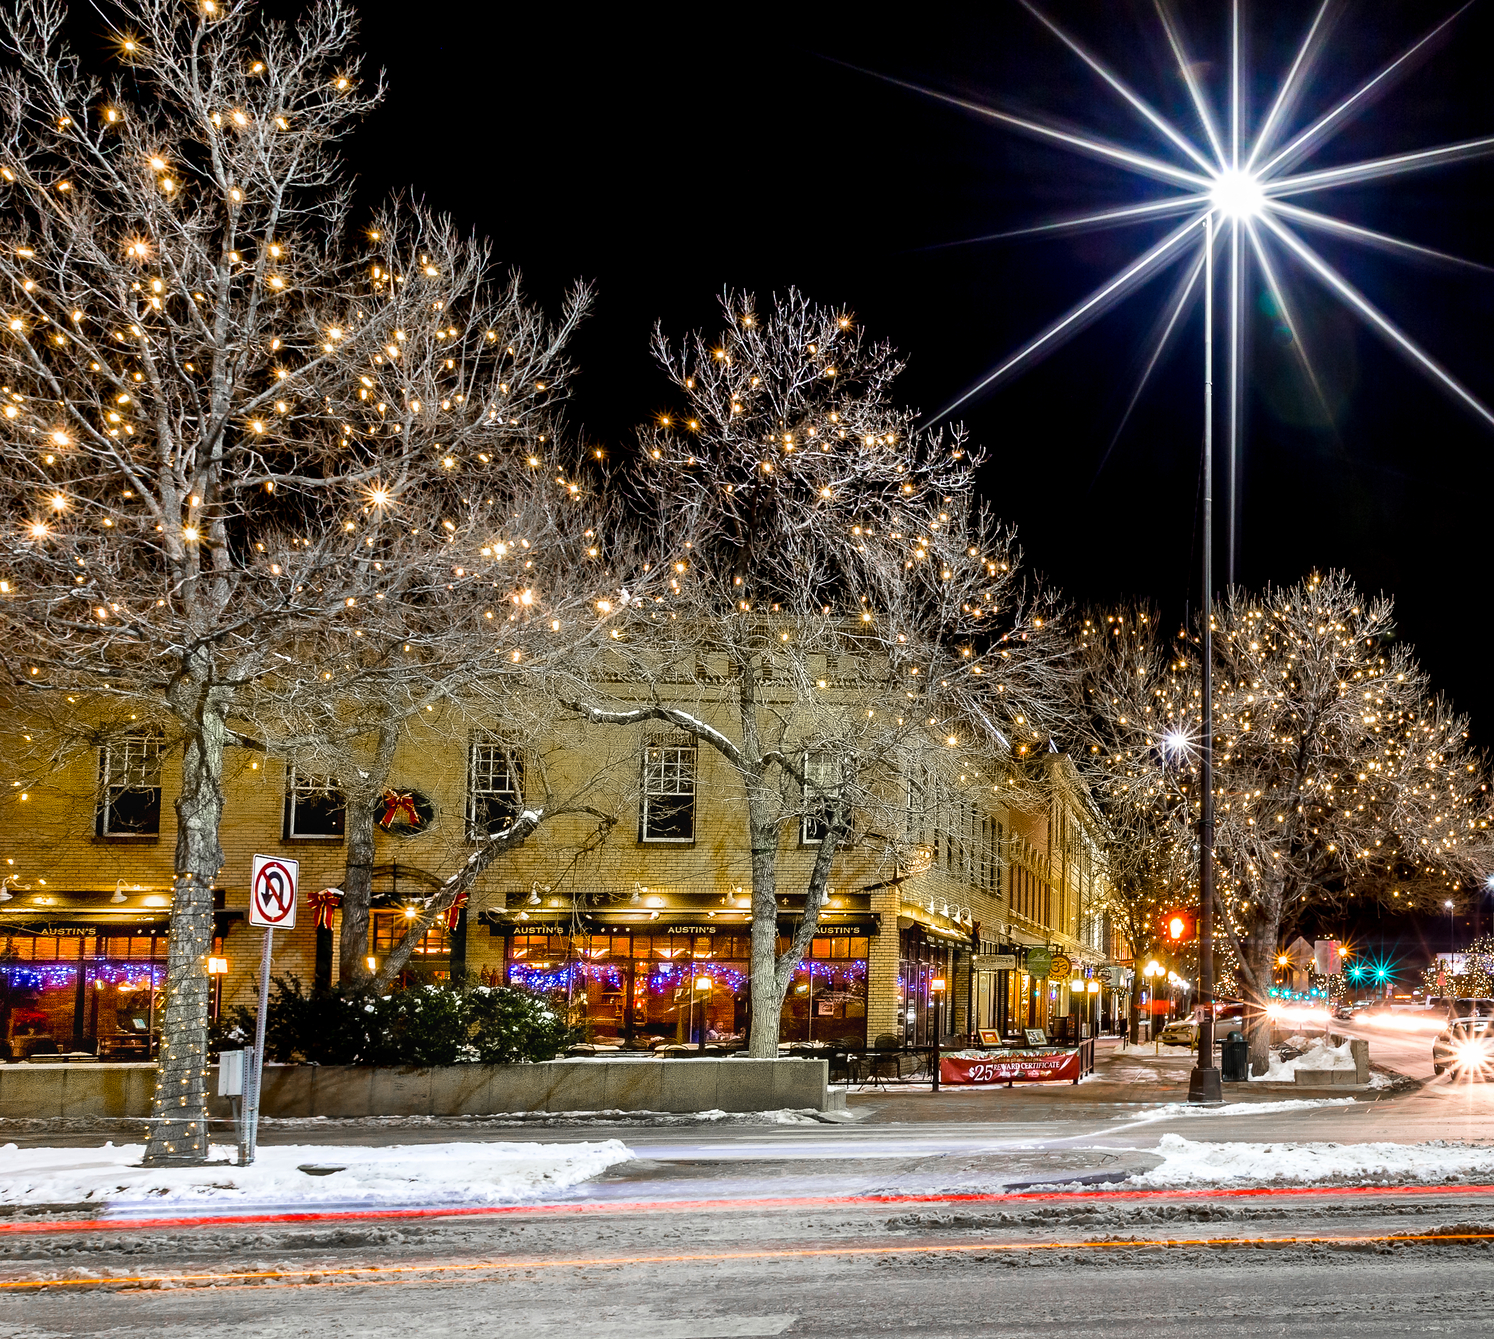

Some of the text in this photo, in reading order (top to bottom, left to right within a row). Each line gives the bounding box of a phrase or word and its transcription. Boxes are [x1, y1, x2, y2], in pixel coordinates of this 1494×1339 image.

[513, 926, 564, 934] AUSTIN'S
[667, 926, 716, 934] AUSTIN'S
[968, 1064, 994, 1081] $25
[993, 1063, 1020, 1071] REWARD
[1020, 1061, 1060, 1070] CERTIFICATE
